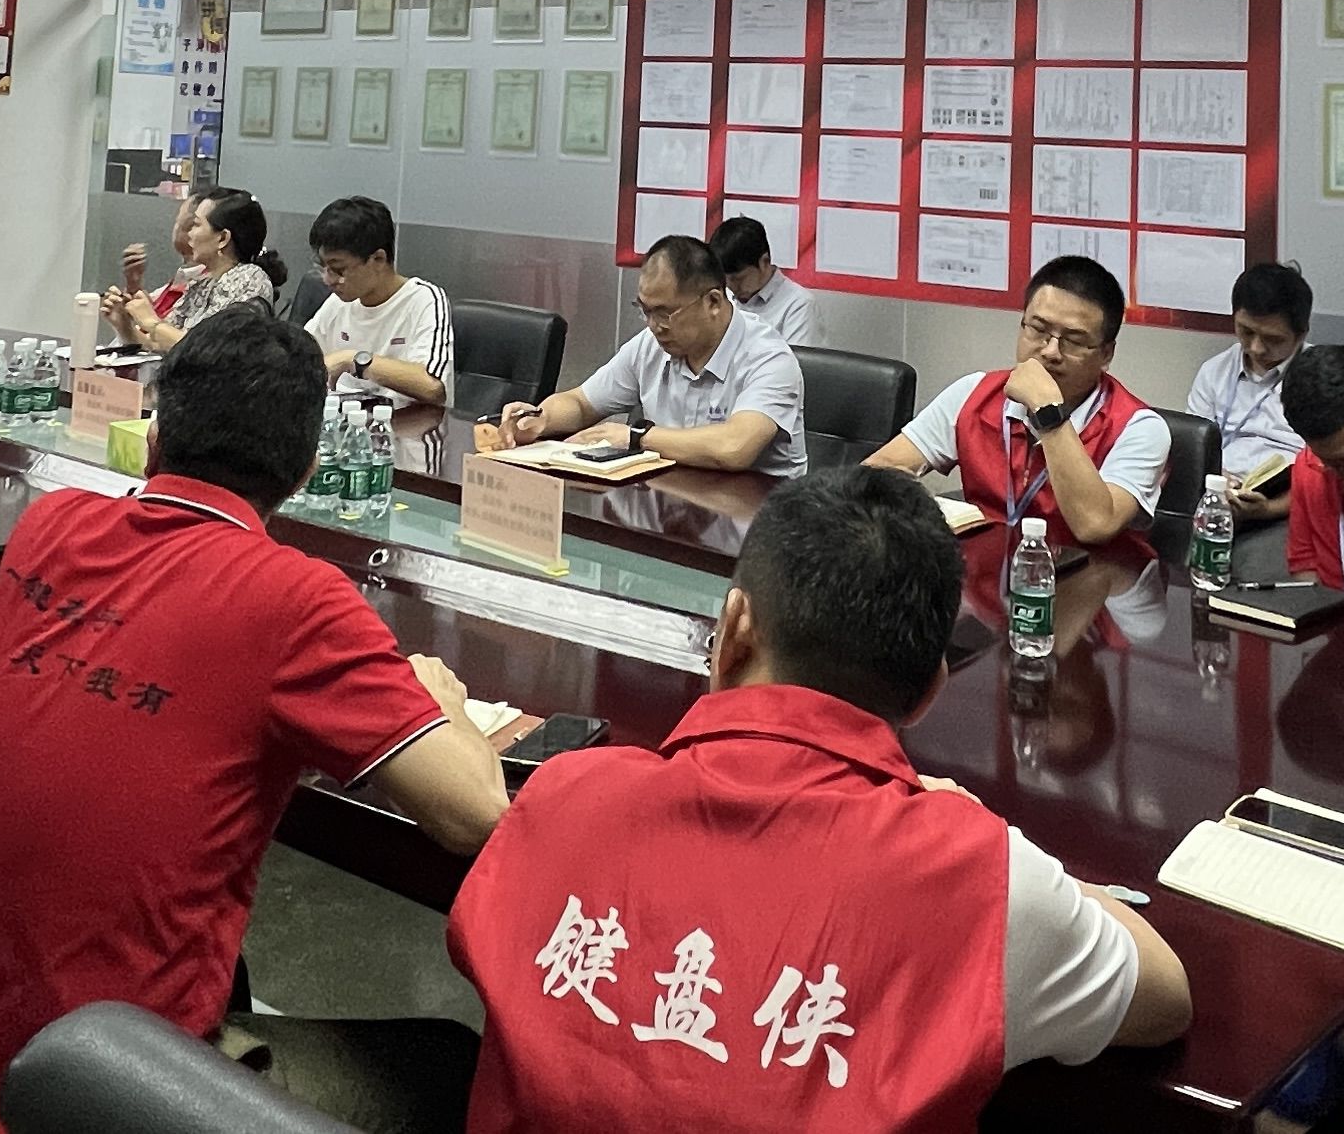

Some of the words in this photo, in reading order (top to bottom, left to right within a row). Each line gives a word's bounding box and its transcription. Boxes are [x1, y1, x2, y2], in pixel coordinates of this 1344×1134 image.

[9, 643, 174, 716] 天下我有
[534, 893, 855, 1088] 键盘侠
